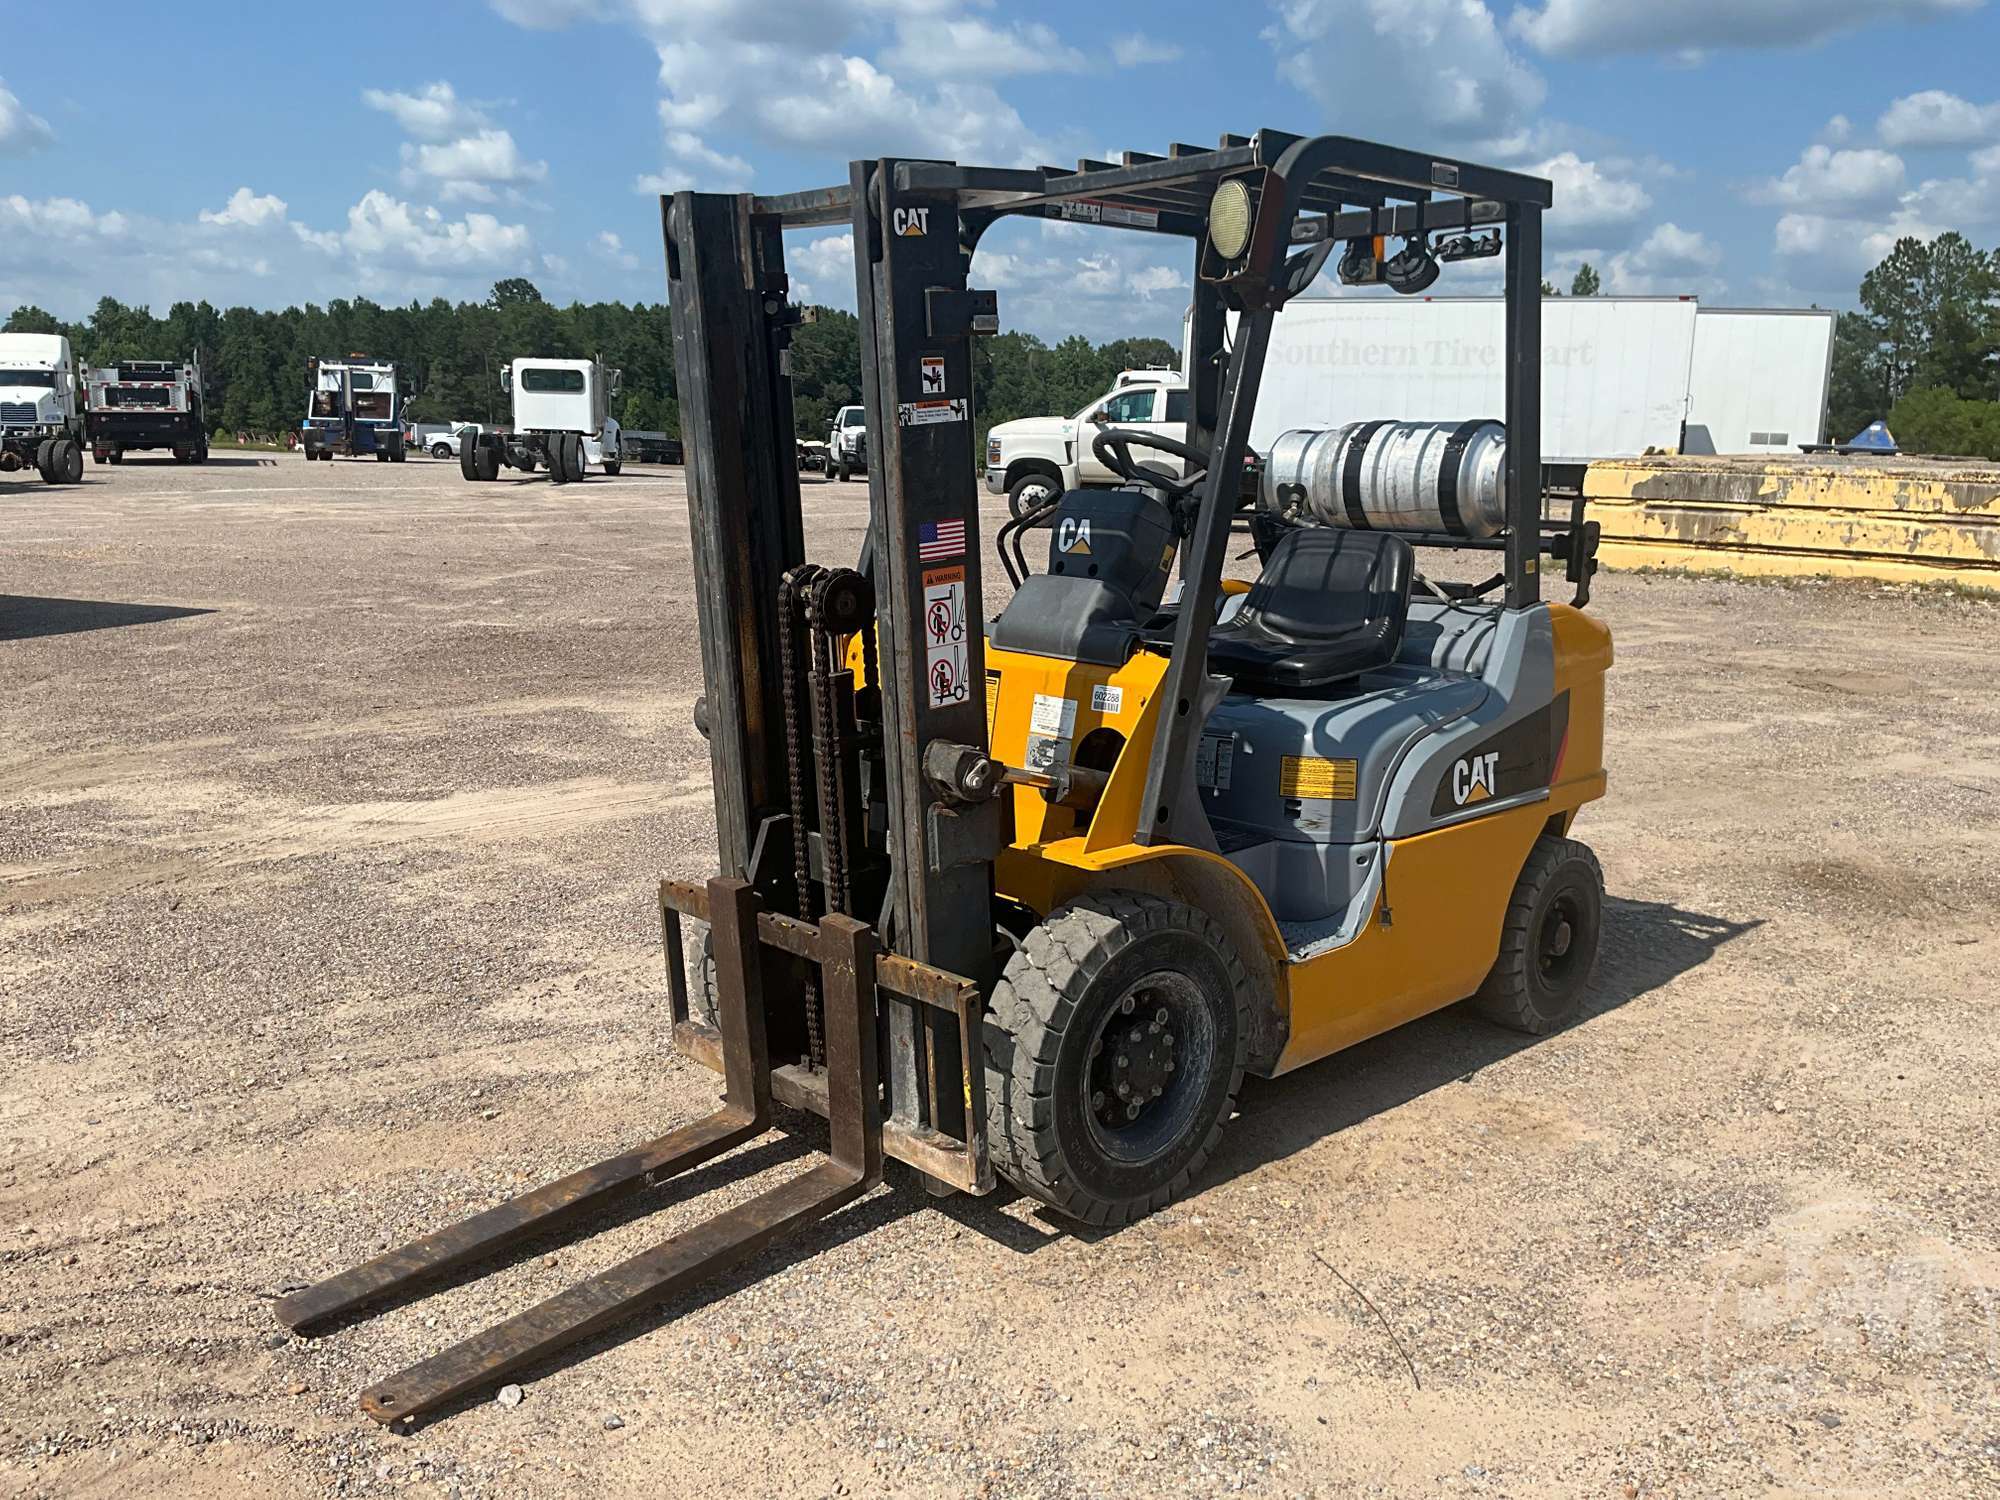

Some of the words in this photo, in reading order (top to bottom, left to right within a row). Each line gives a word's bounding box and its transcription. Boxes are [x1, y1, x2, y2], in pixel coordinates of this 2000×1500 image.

[893, 207, 929, 236] CAT
[1270, 337, 1418, 367] Southern
[1424, 338, 1498, 367] Tire
[1543, 338, 1594, 367] art
[934, 572, 961, 583] WARNING
[1452, 751, 1499, 806] CAT
